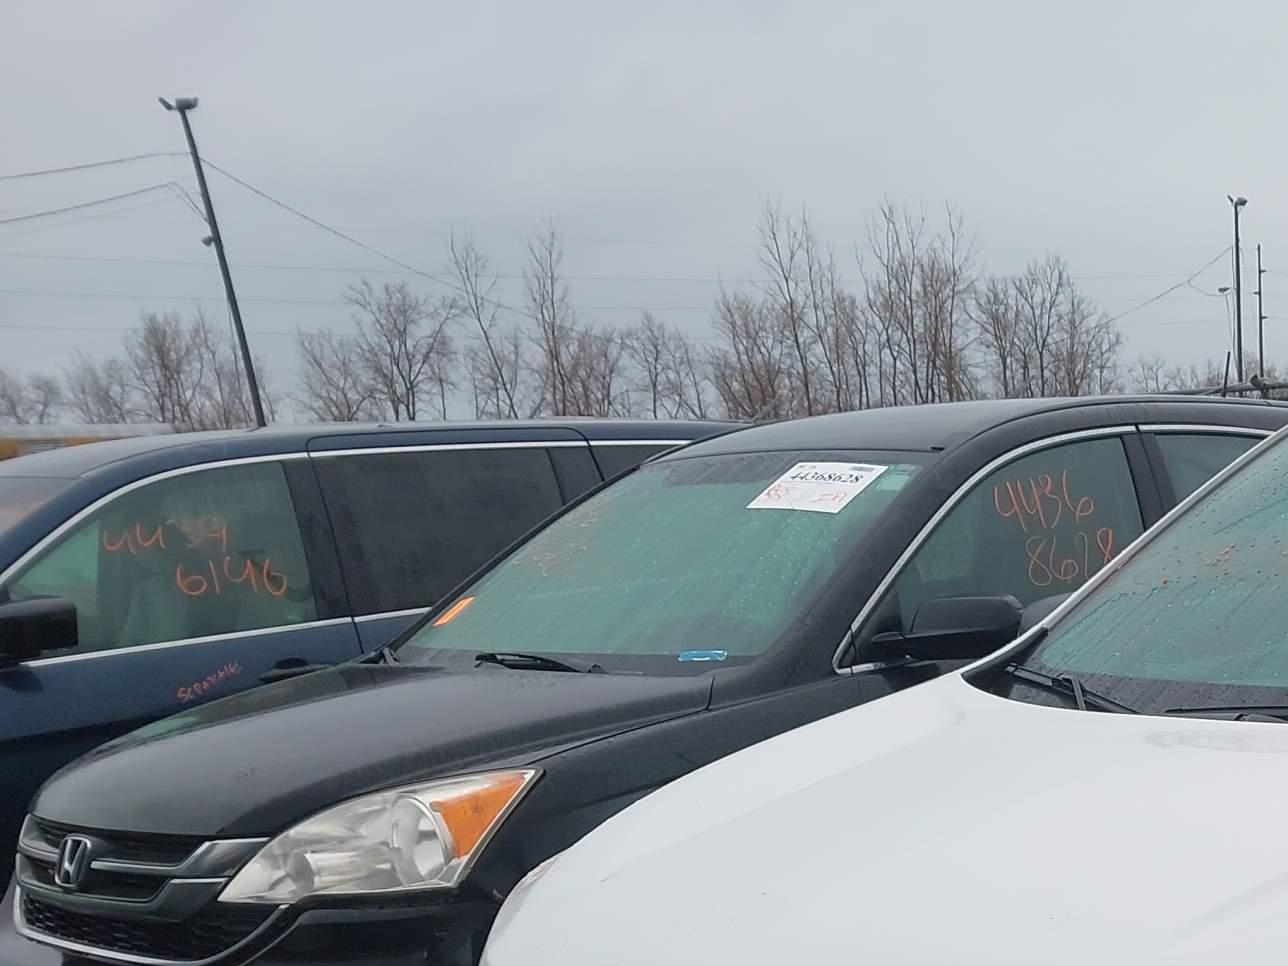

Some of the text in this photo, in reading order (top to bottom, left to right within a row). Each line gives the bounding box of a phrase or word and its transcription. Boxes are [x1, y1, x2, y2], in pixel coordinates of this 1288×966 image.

[790, 472, 864, 484] 44368628
[993, 470, 1094, 532] 4436
[175, 556, 288, 596] 6146
